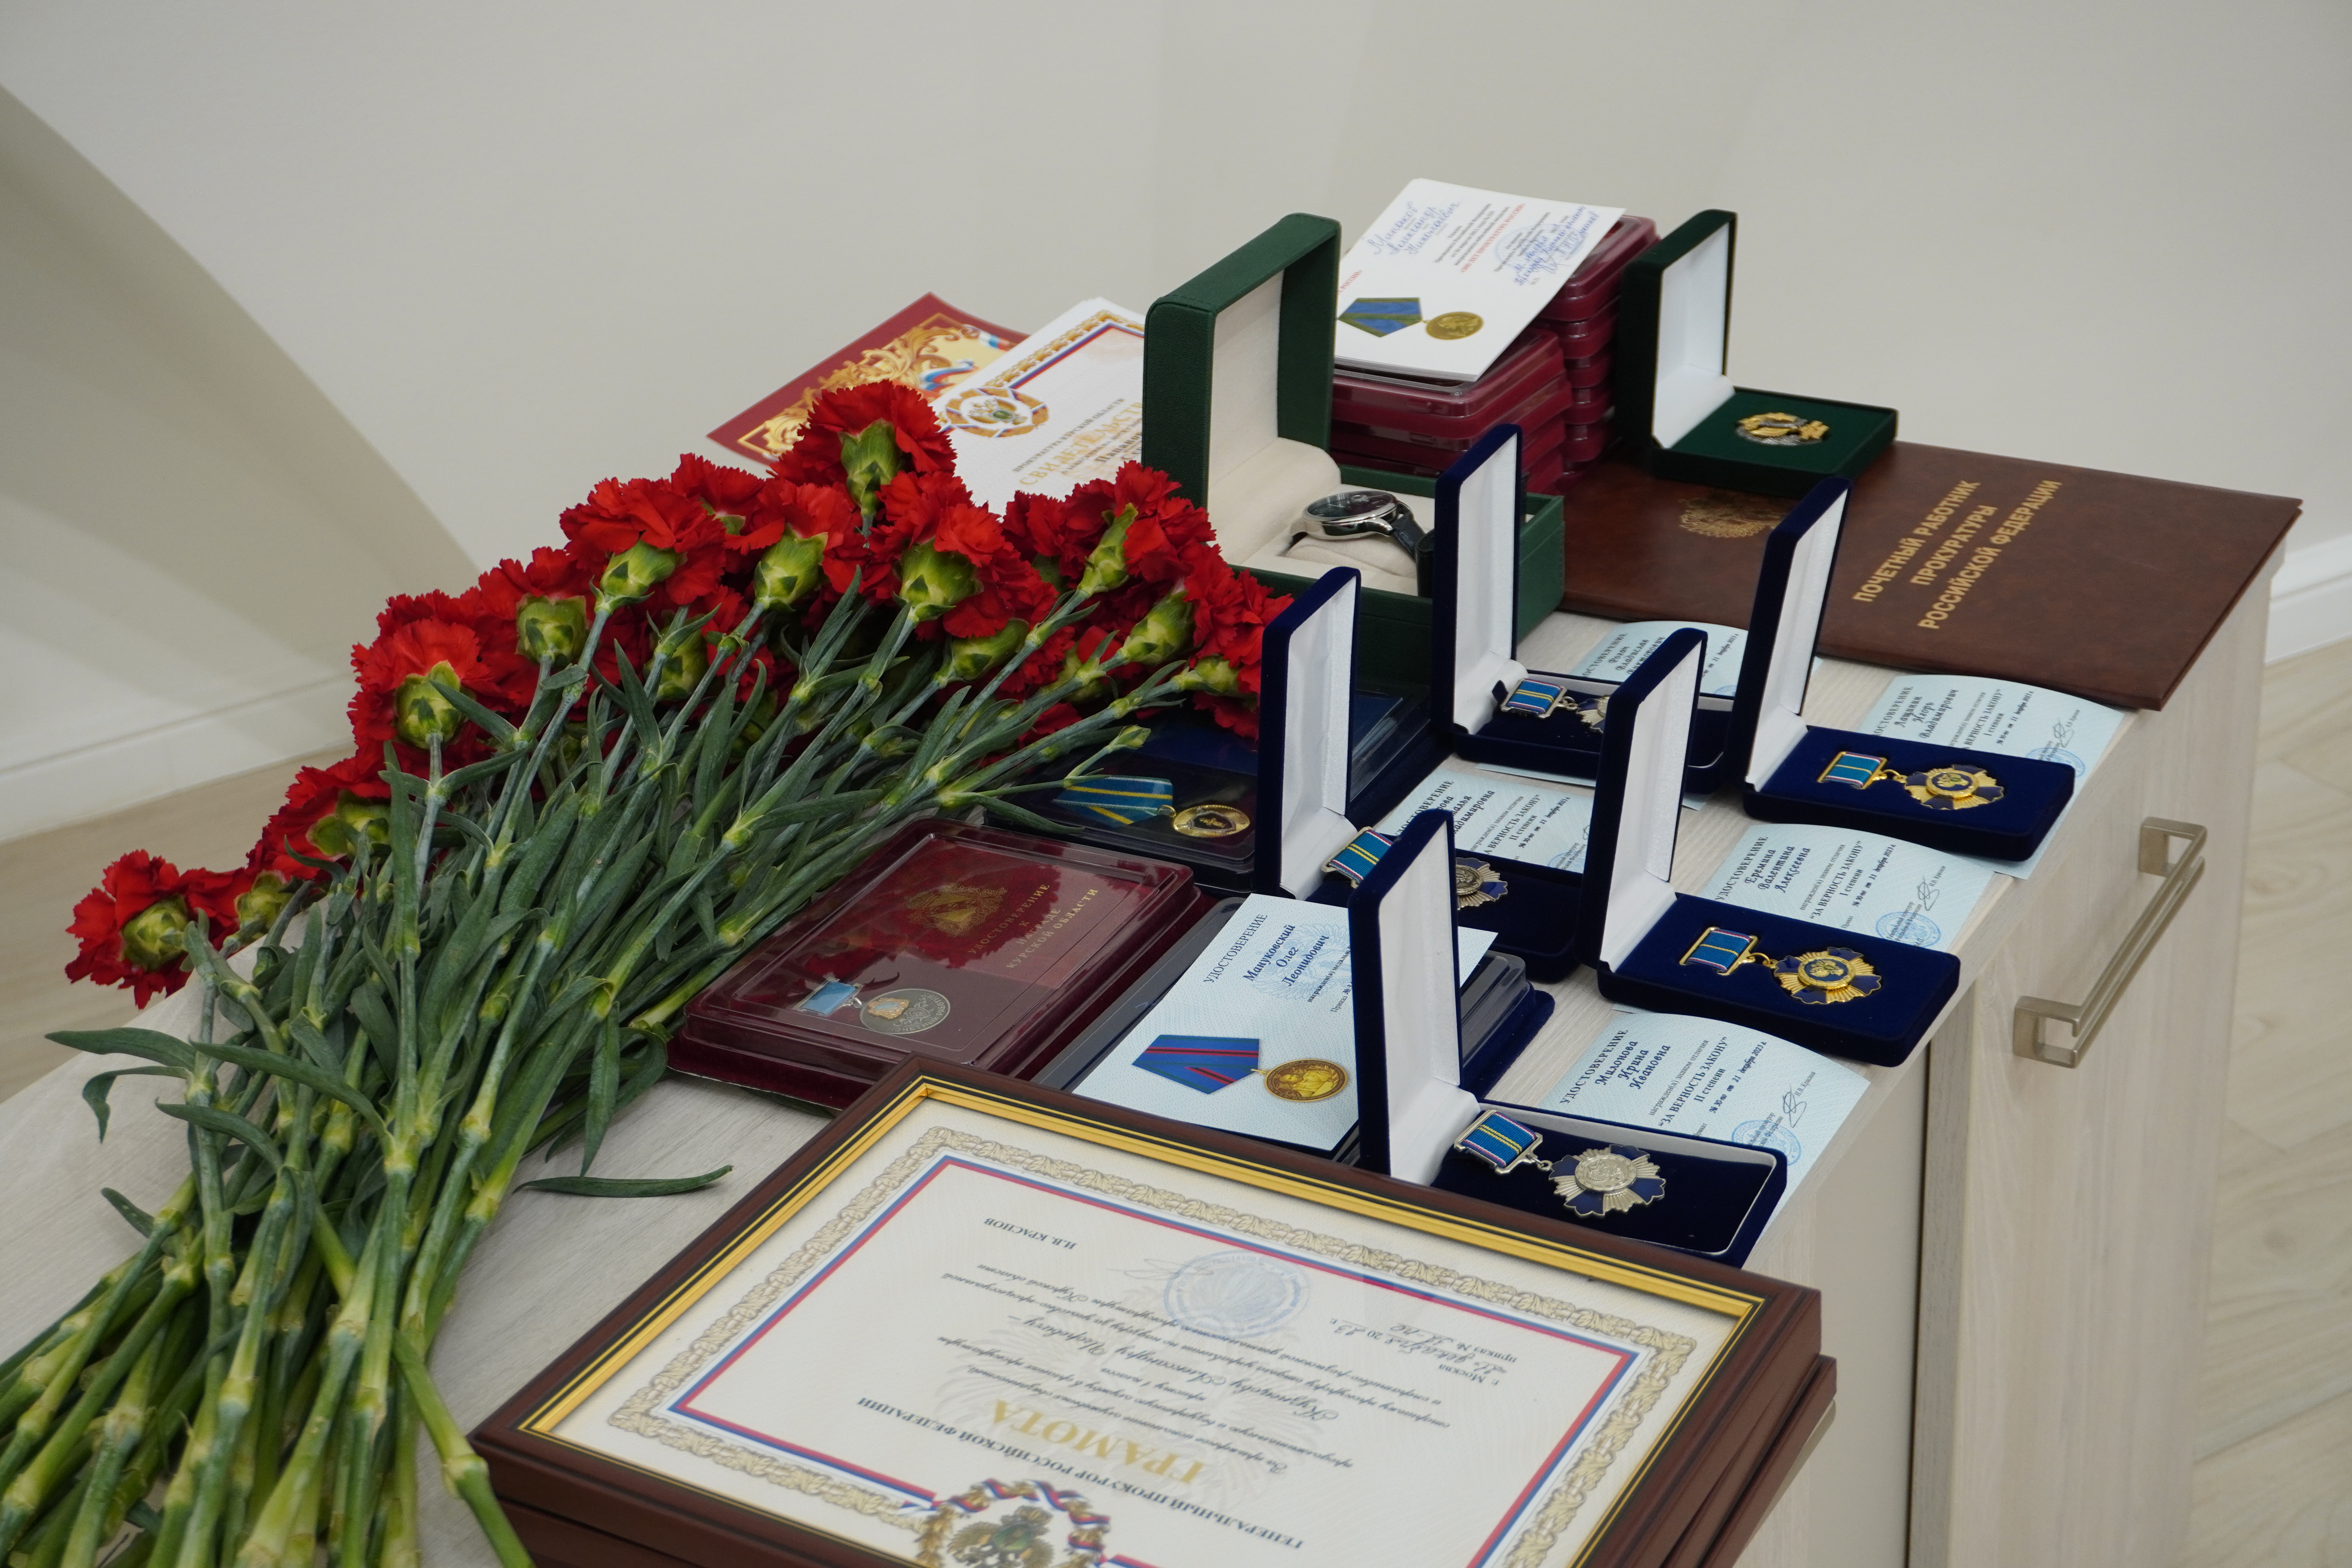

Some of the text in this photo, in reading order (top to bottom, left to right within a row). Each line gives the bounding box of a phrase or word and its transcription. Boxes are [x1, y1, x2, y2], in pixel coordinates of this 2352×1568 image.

[1013, 398, 1126, 473] ПРОКУРАТУРА КУРСКОЙ ОБЛАСТИ
[1852, 480, 1981, 602] ПОЧЕТНЫЙ РАБОТНИК
[1910, 505, 1998, 585] ПРОКУРАТУРЫ
[1918, 480, 2062, 629] РОССИЙСКОЙ ФЕДЕРАЦИИ
[1615, 639, 1649, 672] Владислав
[1627, 636, 1666, 675] Викторович
[1894, 696, 1923, 728] Лащинин
[1912, 702, 1935, 723] Игорь
[1919, 689, 1958, 739] Владимирович
[1964, 691, 1987, 723] знаком отличия
[2014, 701, 2027, 715] декабря
[2023, 693, 2033, 702] 2023
[1964, 715, 1989, 746] ВЕРНОСТЬ
[1988, 713, 2005, 733] степени
[1470, 822, 1498, 852] награжден(а)
[1494, 810, 1510, 825] знаком
[1508, 796, 1525, 811] отличия
[1516, 814, 1538, 835] степени
[1544, 805, 1562, 818] декабря
[1557, 798, 1568, 808] 2023
[1488, 817, 1521, 850] ВЕРНОСТЬ
[1715, 836, 1768, 902] УДОСТОВЕРЕНИЕ
[1745, 849, 1775, 885] Еремина
[1758, 846, 1795, 891] Валентина
[1774, 847, 1811, 894] Алексеевна
[1800, 843, 1846, 910] награжден(а) знаком отличия
[1843, 868, 1864, 894] степени
[1933, 866, 1946, 879] Краснов
[1818, 869, 1847, 909] ВЕРНОСТЬ
[1841, 915, 1854, 929] Приказ
[1869, 872, 1878, 880] 21
[1875, 854, 1888, 874] декабря
[1884, 847, 1894, 860] 2023
[968, 884, 1051, 954] УДОСТОВЕРЕНИЕ
[1006, 888, 1099, 968] КУРСКОЙ ОБЛАСТИ
[1016, 909, 1061, 946] НАГРАДЕ
[1886, 902, 1915, 940] Генеральный прокурор
[1895, 904, 1923, 941] Российской Федерации
[1203, 913, 1268, 983] УДОСТОВЕРЕНИЕ
[1242, 924, 1296, 982] Мануковский
[1276, 946, 1299, 968] Олег
[1280, 934, 1330, 987] Леонидович
[1307, 950, 1351, 1003] награжден(а) медалью
[1330, 996, 1348, 1013] Приказ
[1559, 1029, 1628, 1105] УДОСТОВЕРЕНИЕ
[1595, 1040, 1638, 1086] Милонова
[1617, 1049, 1649, 1080] Ирина
[1630, 1044, 1671, 1091] Ивановна
[1648, 1039, 1710, 1116] награжден(а) знаком отличия
[1709, 1105, 1718, 1114] №
[1714, 1091, 1728, 1107] 30-по
[1732, 1075, 1741, 1083] 21
[1739, 1054, 1758, 1074] декабря
[1751, 1044, 1765, 1059] 2023
[1800, 1071, 1817, 1087] Краснов
[1670, 1067, 1706, 1116] ВЕРНОСТЬ
[1693, 1067, 1726, 1104] II степени
[1760, 1112, 1776, 1132] прокурор
[1764, 1116, 1784, 1137] Федерации
[984, 1217, 1078, 1251] И.В. КРАСНОВ
[977, 1263, 1027, 1284] области
[1025, 1277, 1089, 1304] Курской
[1092, 1299, 1177, 1330] прокуратуры
[1107, 1321, 1160, 1343] надзору
[1161, 1339, 1179, 1349] по
[1181, 1325, 1284, 1357] деятельностью
[1367, 1329, 1384, 1340] 20
[1024, 1316, 1339, 1422] Кузнецову Александру Игоревичу
[1180, 1344, 1254, 1370] управления
[1456, 1341, 1517, 1364] приказ №
[1101, 1367, 1207, 1403] юристу класса
[1255, 1365, 1304, 1385] отдела
[1438, 1364, 1486, 1385] Москва
[937, 1336, 1353, 1469] продолжительную безупречную службу органах прокуратуры
[1052, 1394, 1121, 1420] служебных
[1304, 1380, 1377, 1408] прокурору
[1123, 1416, 1194, 1442] исполнение
[1379, 1403, 1451, 1429] старшему
[989, 1399, 1207, 1485] ГРАМОТА
[1195, 1438, 1265, 1464] примерное
[856, 1397, 1305, 1550] ГЕНЕРАЛЬНЫЙ ПРОКУРОР РОССИЙСКОЙ ФЕДЕРАЦИИ
